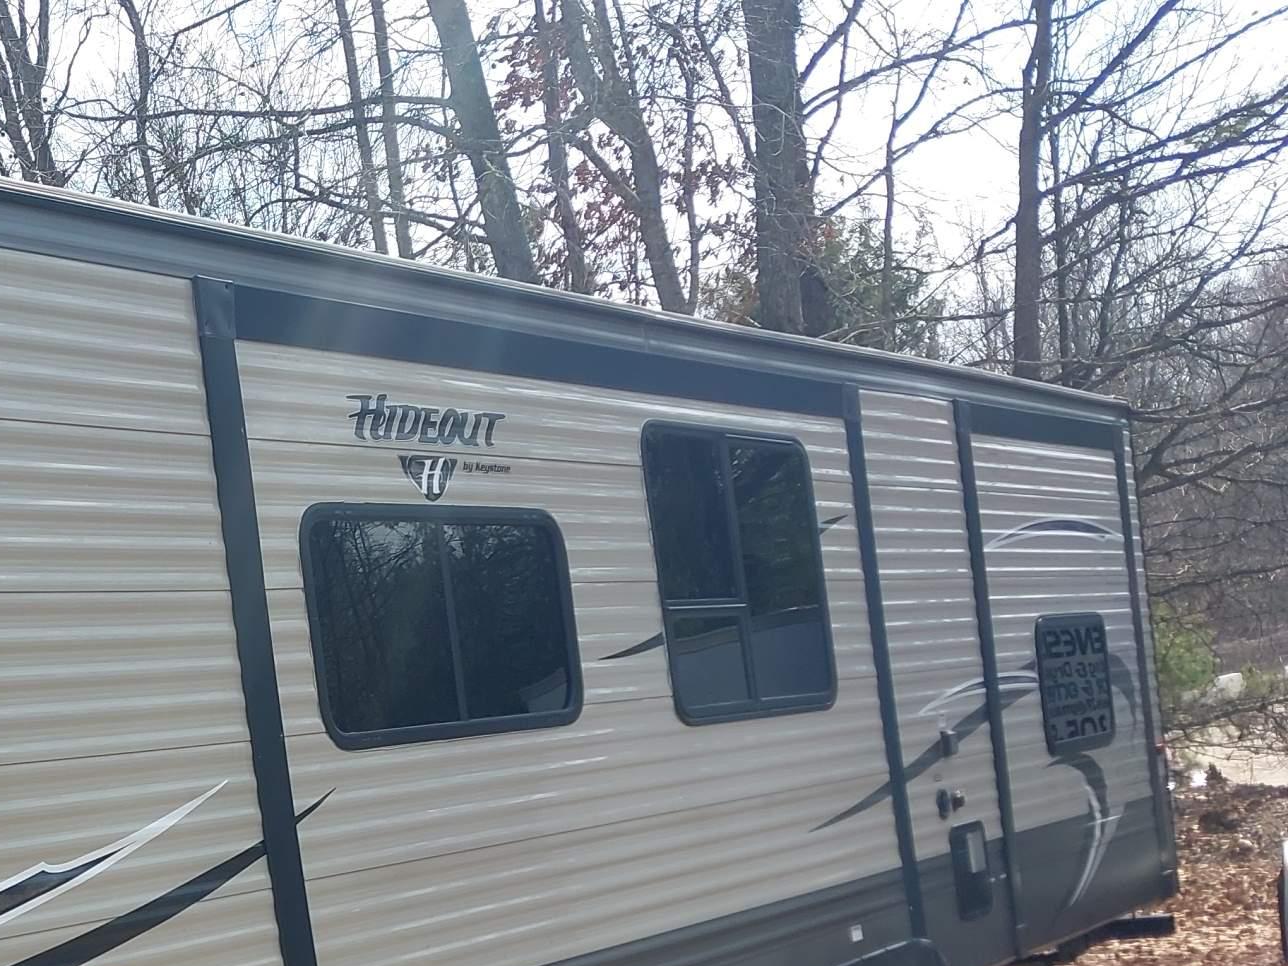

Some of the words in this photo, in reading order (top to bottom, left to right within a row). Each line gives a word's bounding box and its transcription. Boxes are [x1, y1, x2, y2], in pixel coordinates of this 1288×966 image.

[346, 393, 506, 447] HIDEOUT
[463, 461, 473, 473] by
[475, 461, 511, 475] Keystone
